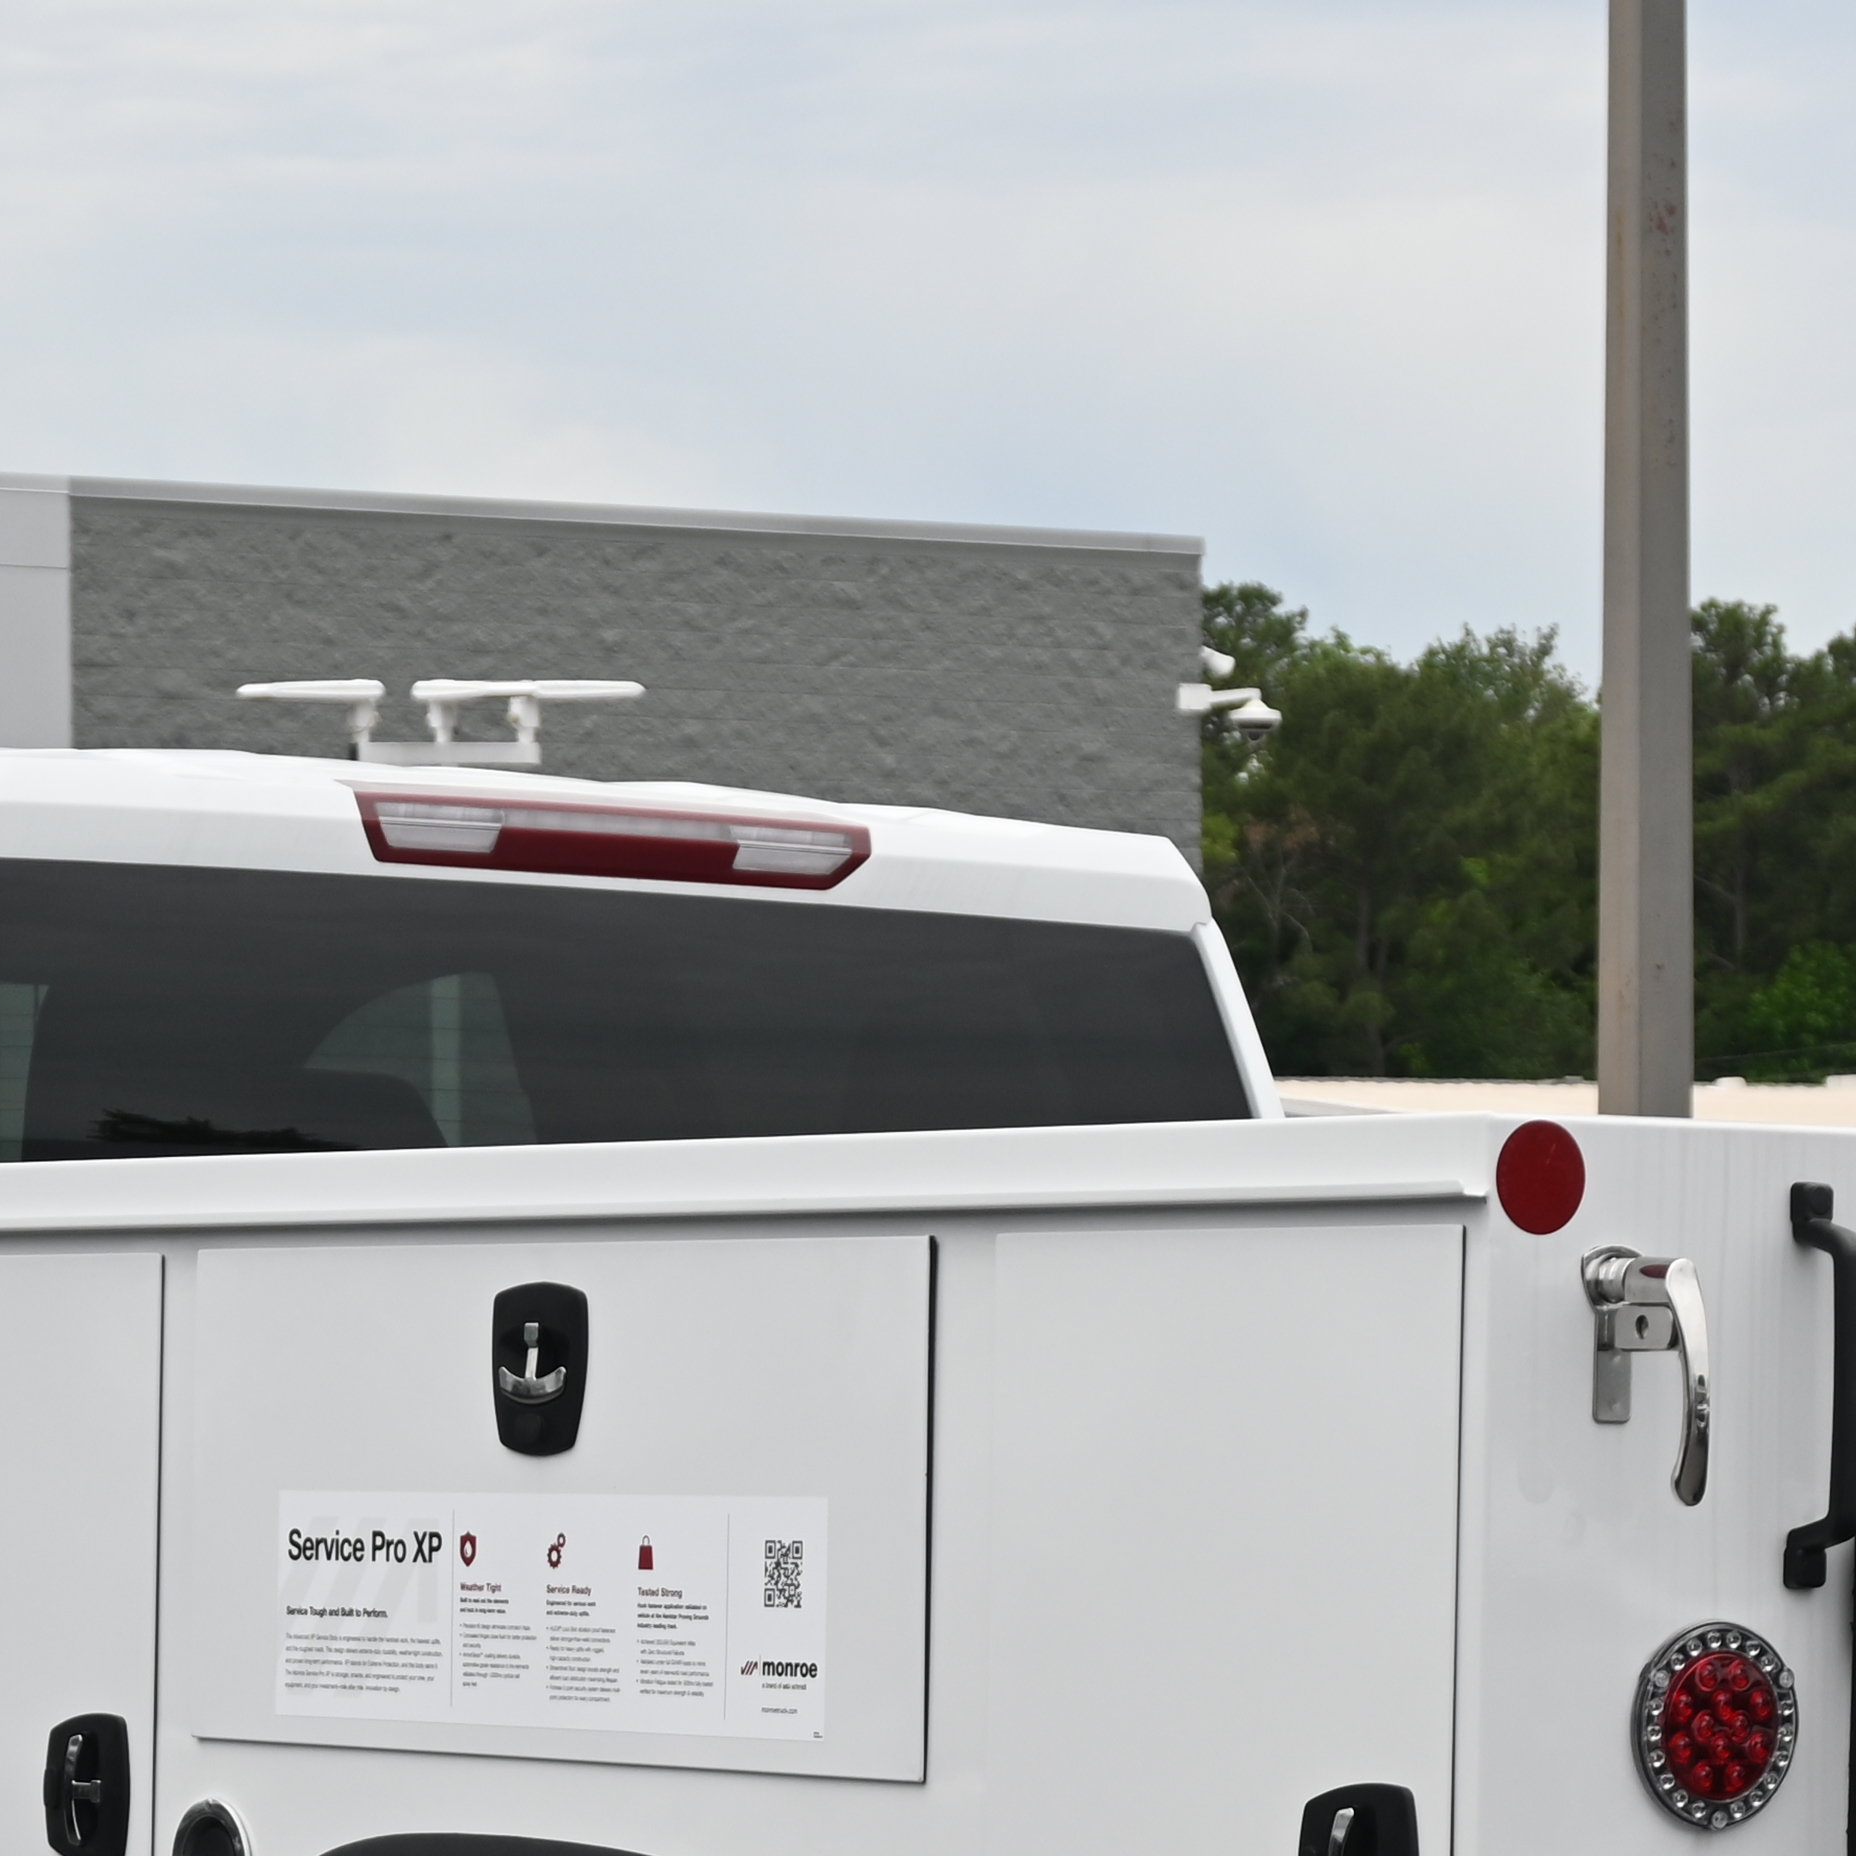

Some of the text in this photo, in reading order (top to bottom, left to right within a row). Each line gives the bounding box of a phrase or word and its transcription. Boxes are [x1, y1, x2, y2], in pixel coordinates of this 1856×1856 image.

[288, 1528, 443, 1563] Service Pro XP
[546, 1584, 592, 1596] Service Ready
[637, 1587, 683, 1599] Tested Strong
[762, 1660, 818, 1678] monroe
